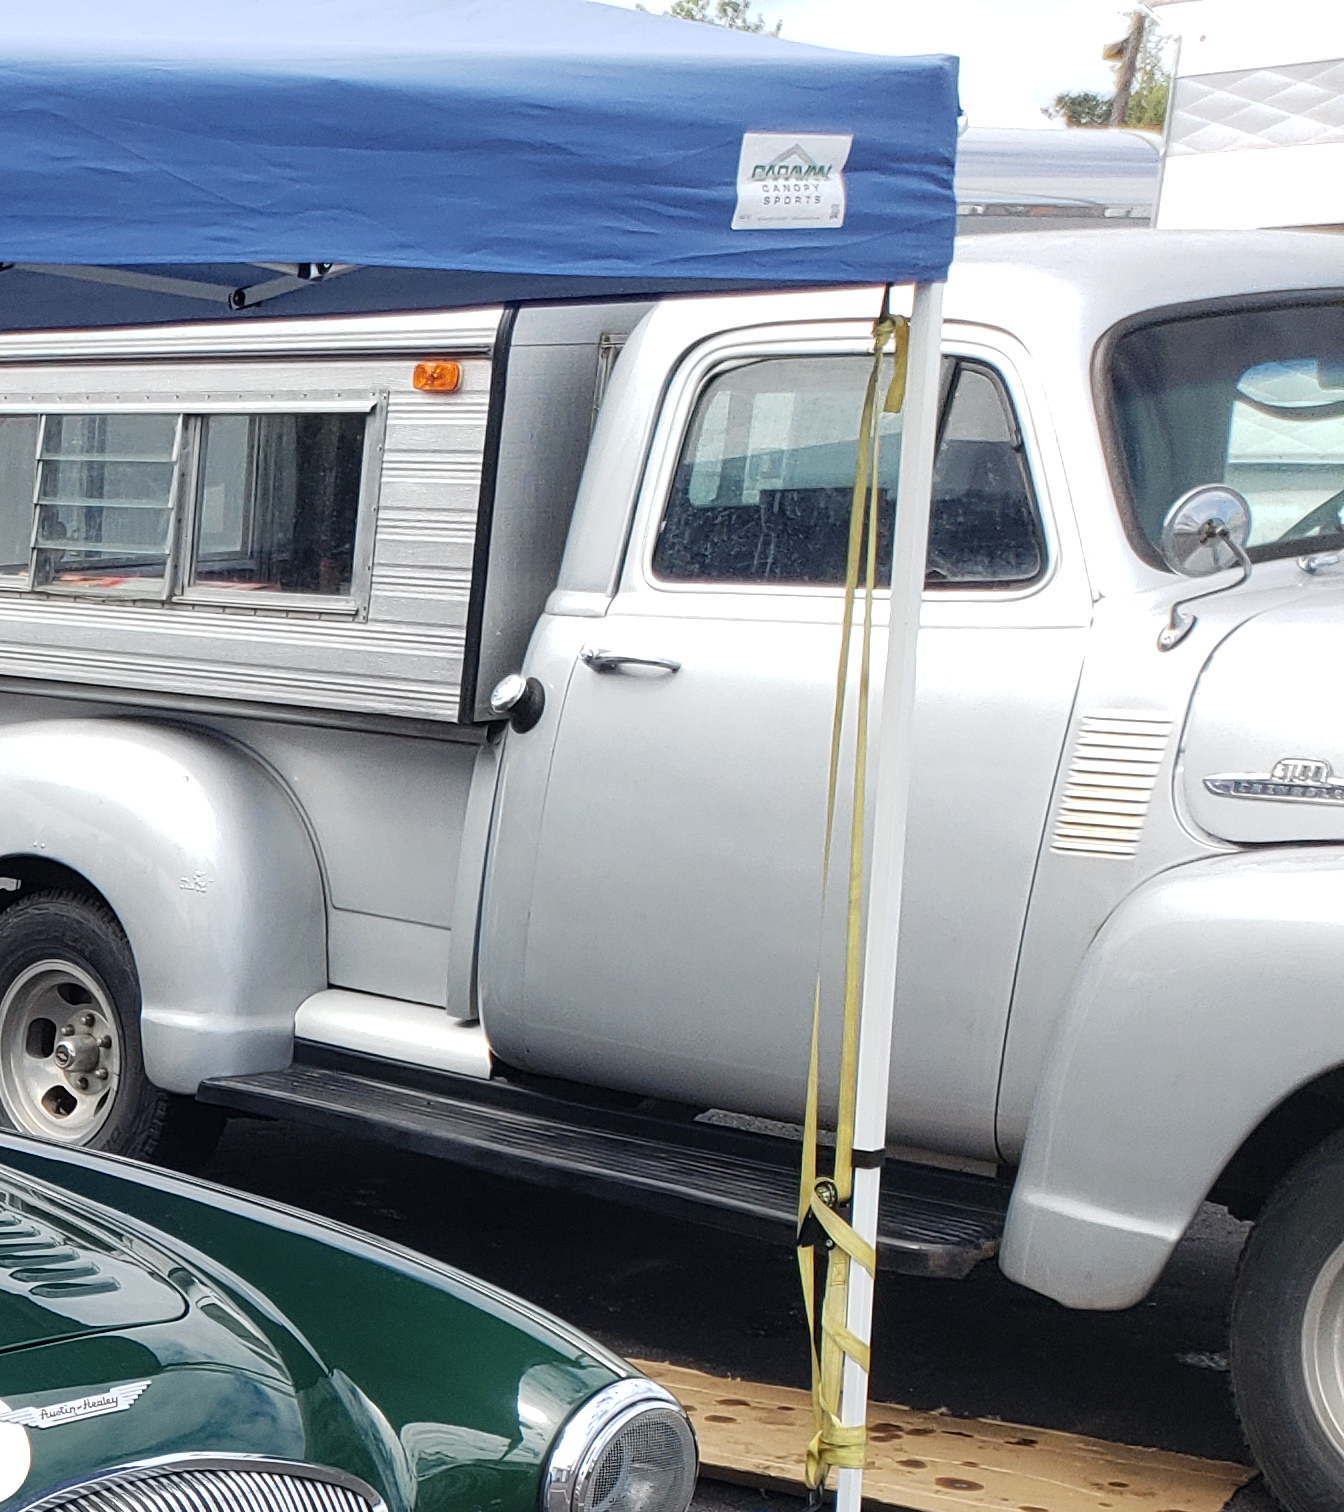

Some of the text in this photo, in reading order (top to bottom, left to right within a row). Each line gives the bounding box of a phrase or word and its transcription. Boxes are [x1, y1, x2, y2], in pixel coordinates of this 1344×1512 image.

[761, 184, 820, 193] CANOPY
[763, 196, 821, 205] SPORTS
[39, 1395, 119, 1421] Austin-Healey
